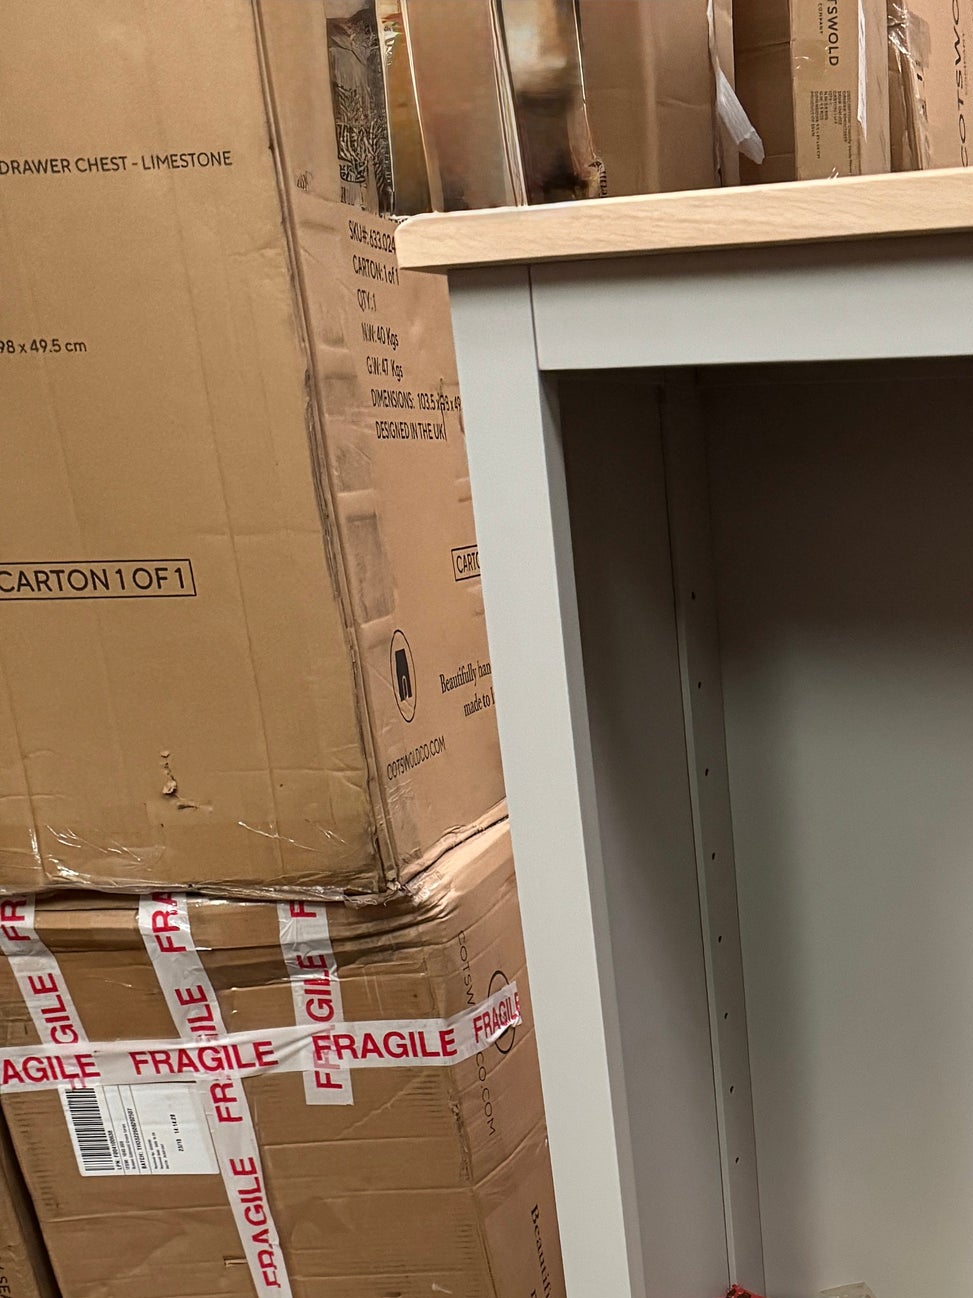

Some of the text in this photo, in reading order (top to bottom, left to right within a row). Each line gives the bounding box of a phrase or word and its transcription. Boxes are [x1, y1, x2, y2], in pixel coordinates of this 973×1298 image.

[0, 158, 71, 175] DRAWER
[75, 156, 128, 173] CHEST
[141, 151, 233, 171] LIMESTONE
[18, 344, 28, 354] x
[30, 338, 62, 354] 49.5
[65, 341, 87, 352] cm
[391, 359, 404, 382] Kgs
[376, 421, 444, 440] DESIGNED IN THE UK
[0, 567, 185, 593] CARTON 1 OF 1
[439, 661, 478, 695] Beautifully
[463, 692, 491, 718] made to
[129, 1040, 279, 1075] FRAGILE
[312, 1028, 458, 1061] FRAGILE
[1, 1053, 101, 1085] AGILE
[230, 1156, 281, 1288] FRAGILE
